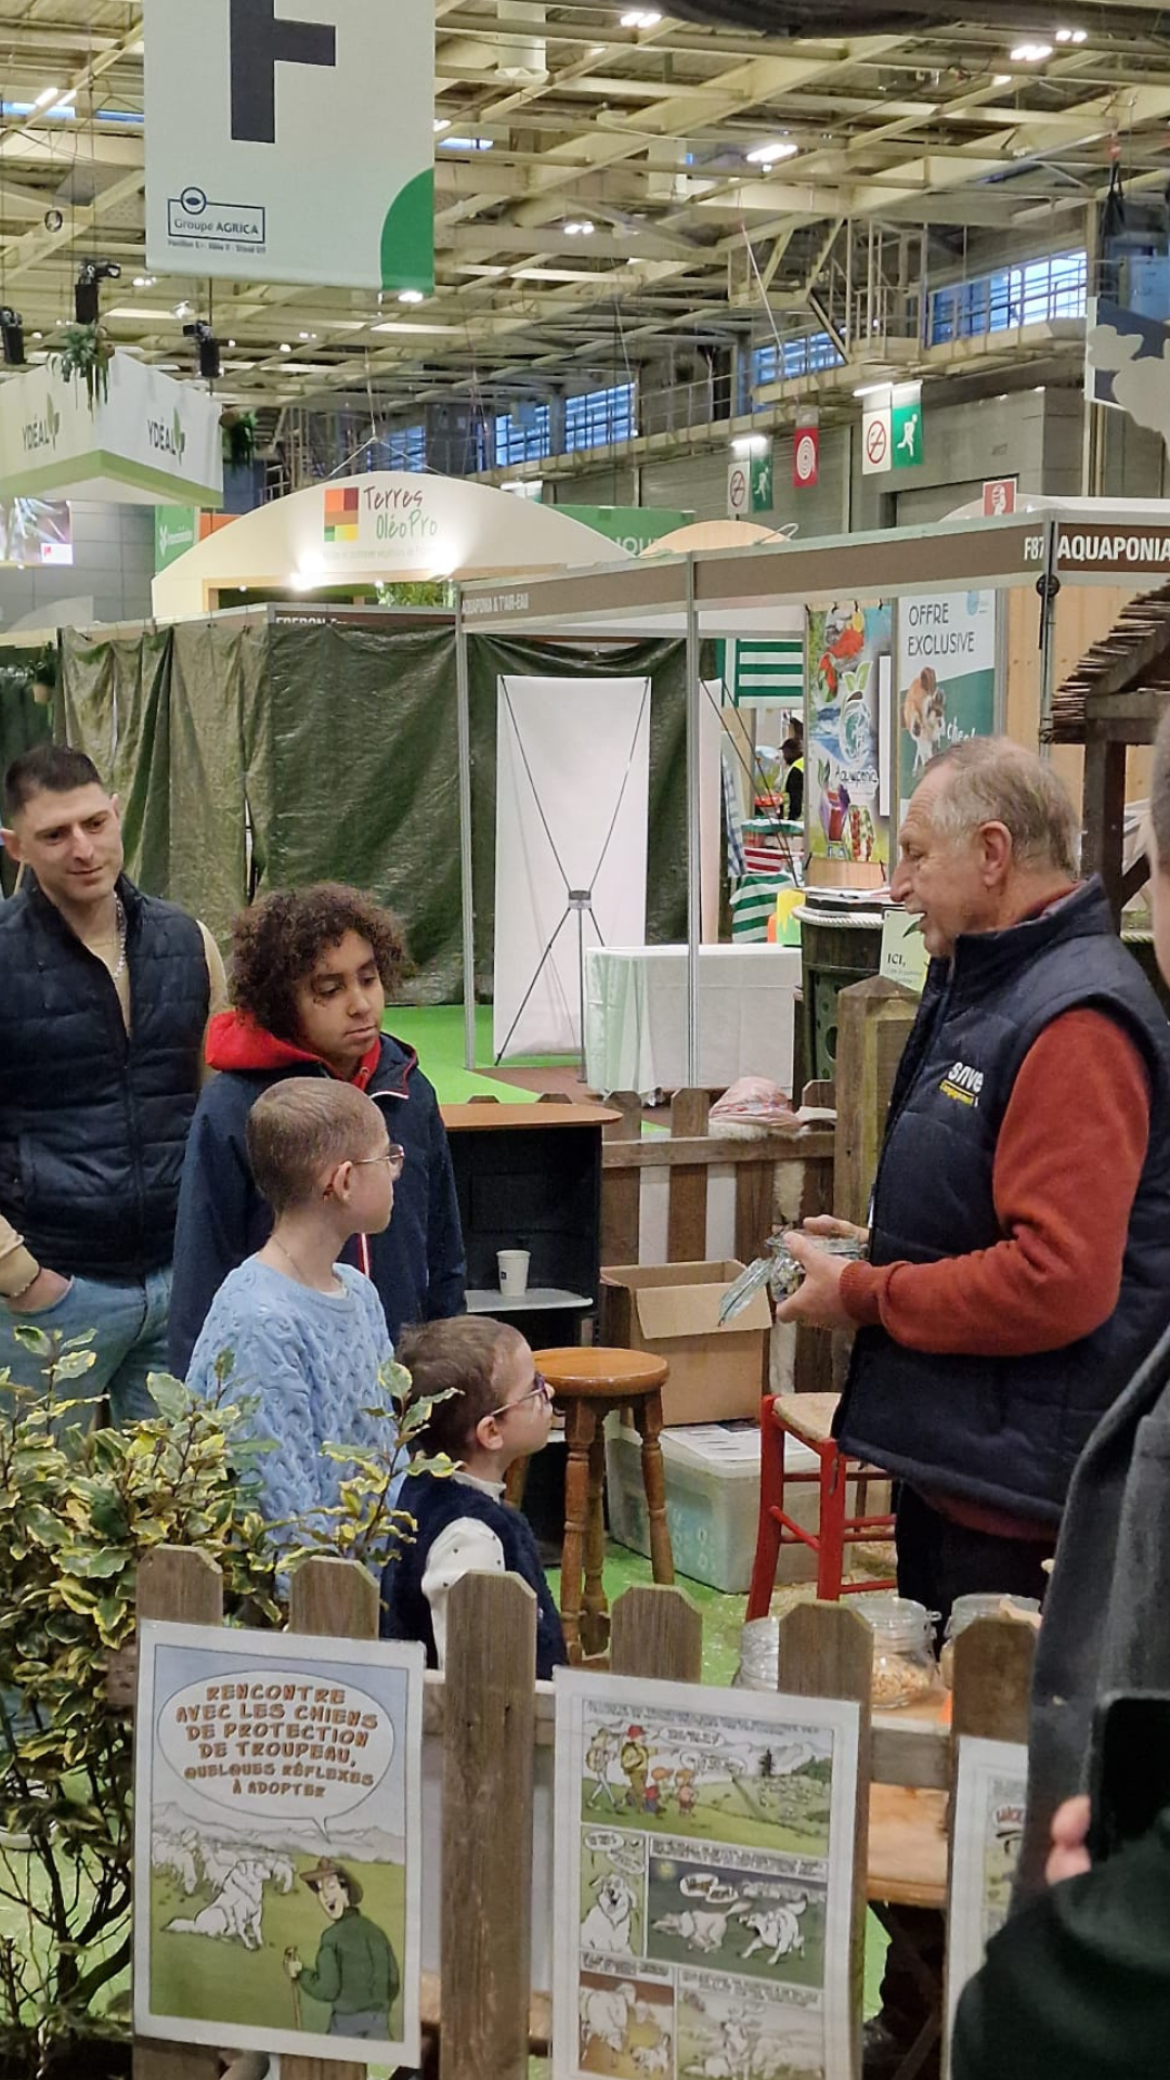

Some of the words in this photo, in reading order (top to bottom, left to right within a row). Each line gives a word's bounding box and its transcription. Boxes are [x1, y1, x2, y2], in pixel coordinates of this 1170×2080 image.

[174, 219, 213, 232] Groupe
[216, 222, 259, 235] AGRICA
[363, 486, 423, 511] Terres
[1057, 535, 1170, 561] AQUAPONIA
[908, 602, 949, 627] OFFRE
[908, 631, 975, 656] EXCLUSIVE
[887, 953, 906, 967] ICI,
[206, 1683, 346, 1705] RENCONTRE
[176, 1704, 231, 1723] AVEC
[239, 1703, 286, 1720] LES
[294, 1705, 379, 1730] CHIENS
[186, 1723, 216, 1741] DE
[223, 1722, 370, 1748] PROTECTION
[199, 1742, 228, 1759] DE
[236, 1741, 357, 1768] TROUPEAU,
[184, 1763, 276, 1780] QUELQUES
[282, 1762, 375, 1787] RÉFLEXES
[232, 1779, 242, 1795] À
[247, 1780, 326, 1798] ADOPTER
